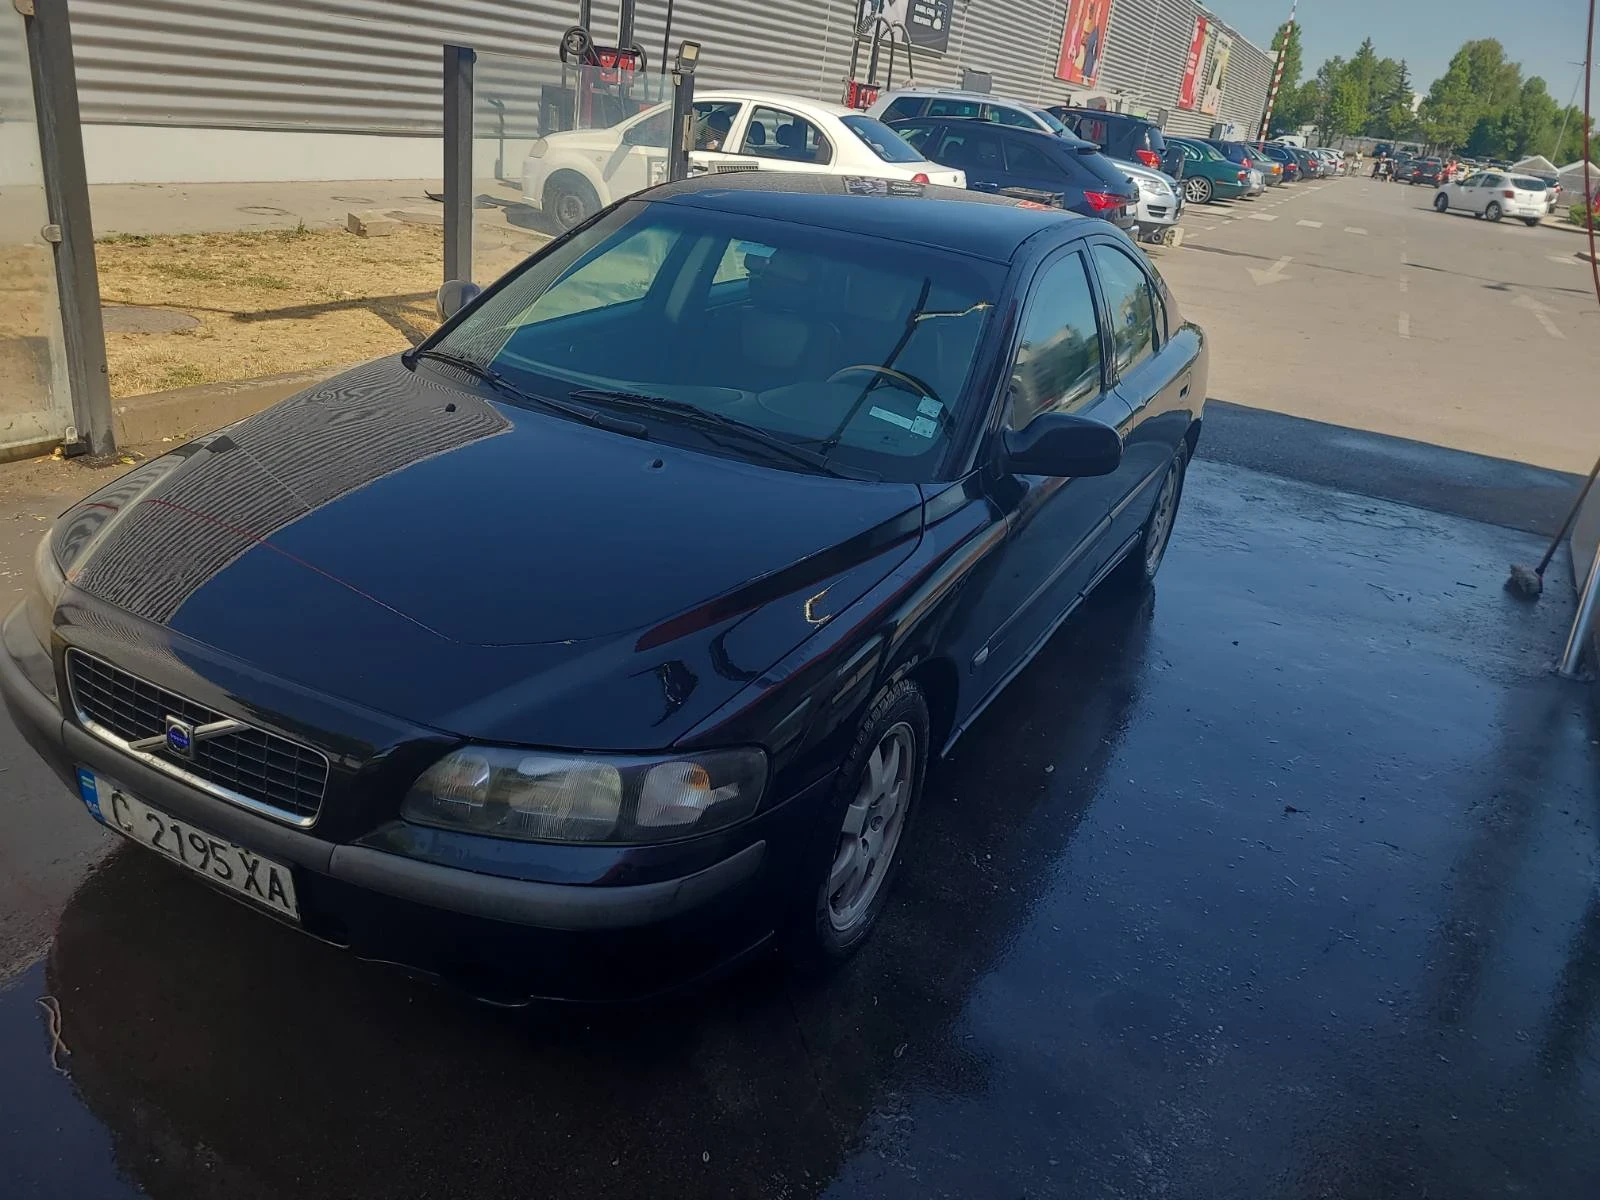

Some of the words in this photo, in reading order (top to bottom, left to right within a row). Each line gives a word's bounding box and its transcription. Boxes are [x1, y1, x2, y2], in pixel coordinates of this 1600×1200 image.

[111, 793, 133, 831] C
[146, 812, 233, 881] 2195
[239, 851, 291, 909] XA
